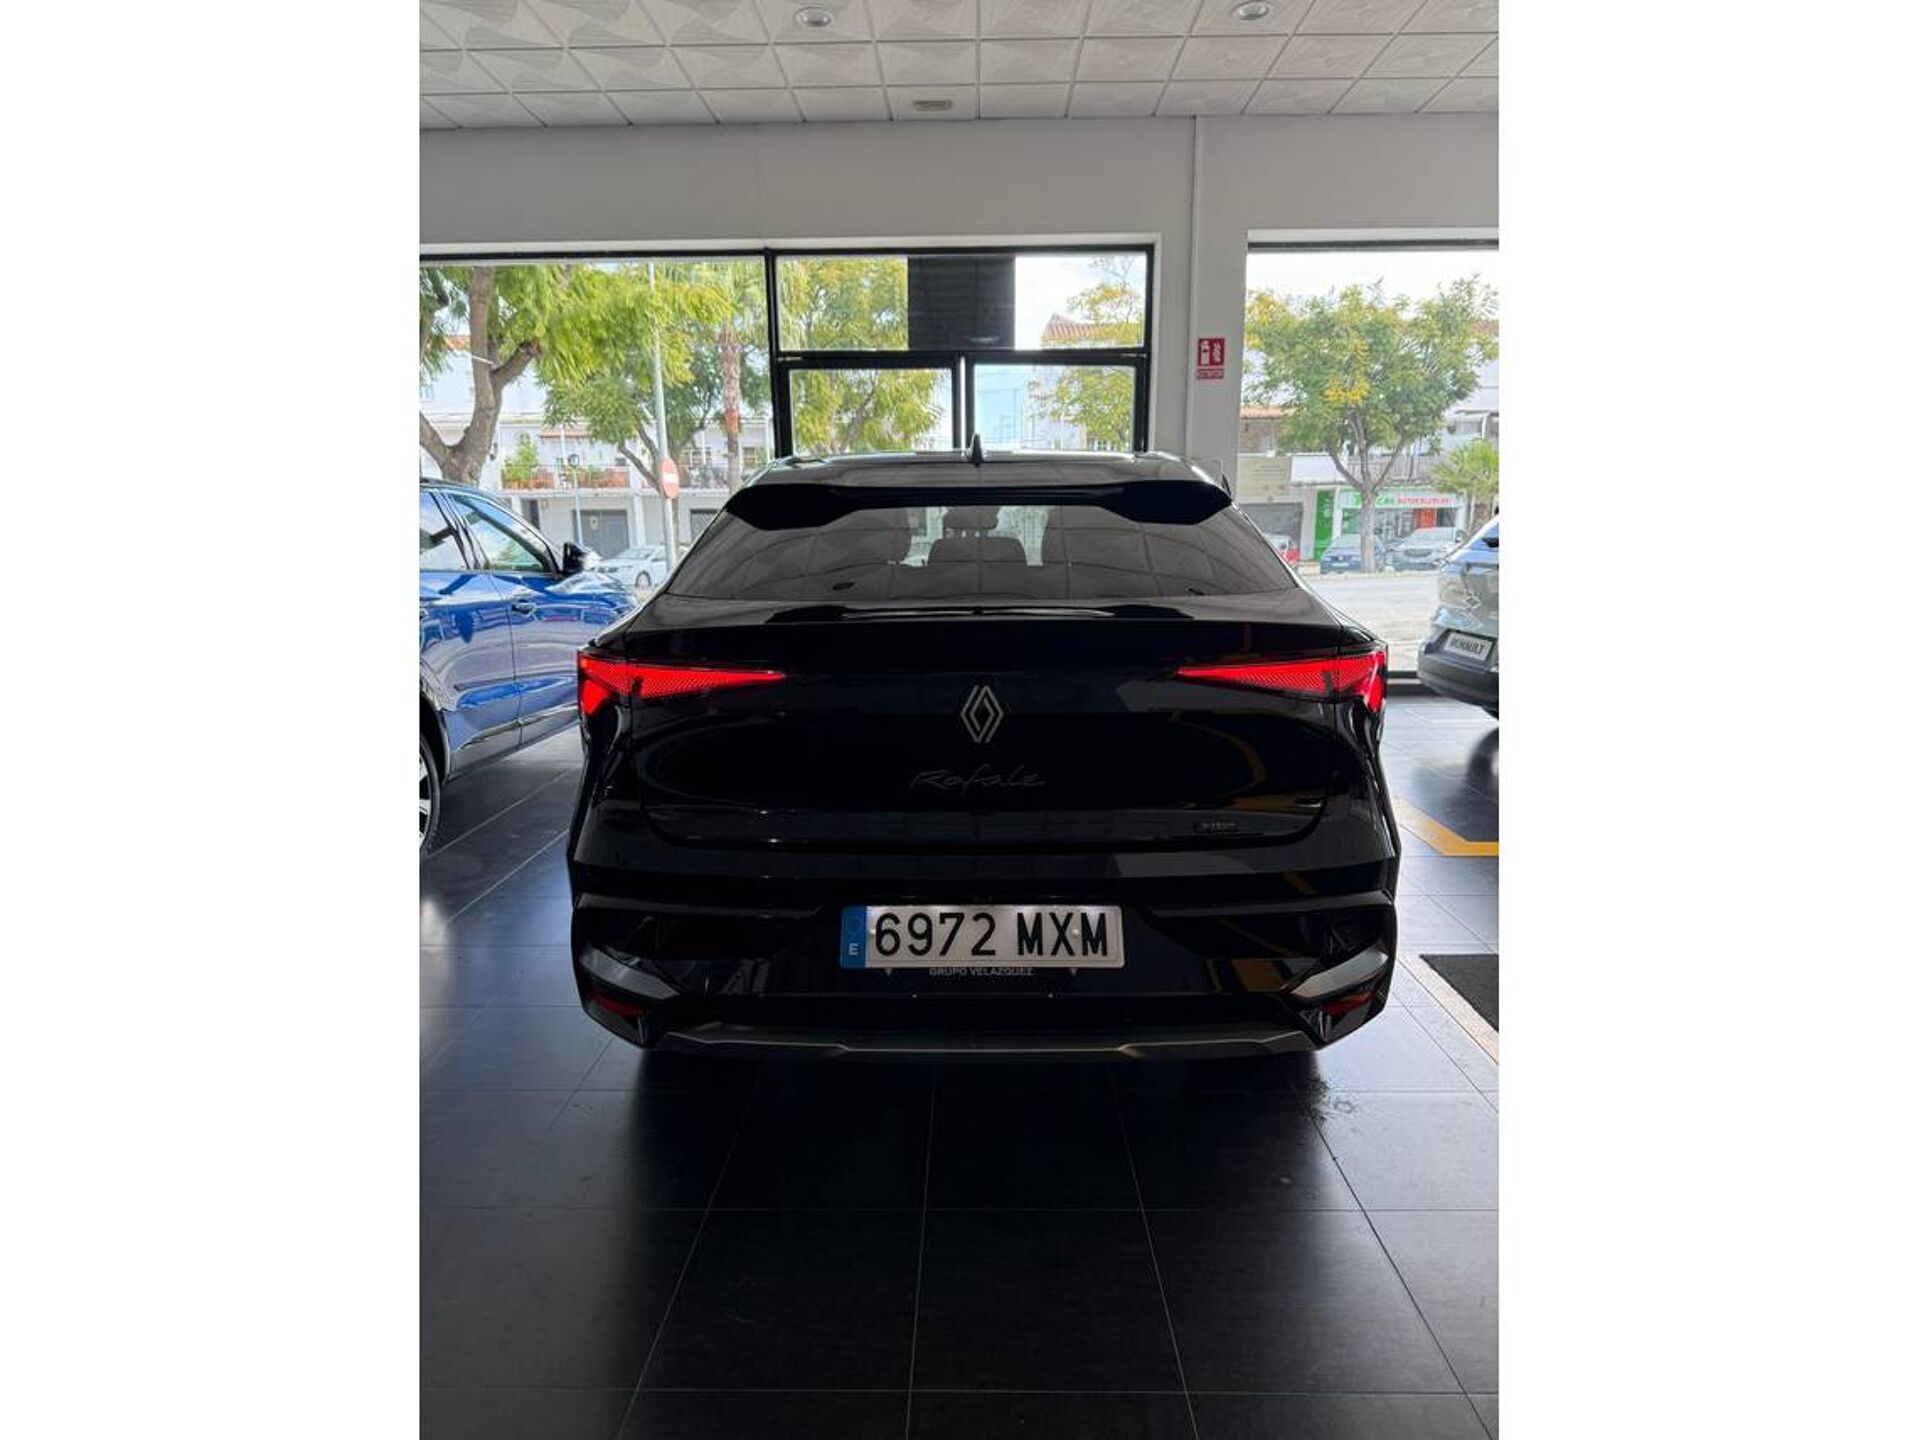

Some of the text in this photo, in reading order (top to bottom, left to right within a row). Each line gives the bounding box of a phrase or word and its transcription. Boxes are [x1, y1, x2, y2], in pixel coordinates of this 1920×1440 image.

[908, 763, 1047, 797] Rafale
[874, 912, 1108, 957] 6972 MXM
[848, 943, 858, 955] E
[929, 967, 1033, 976] GRUPO VELAZQUEZ
